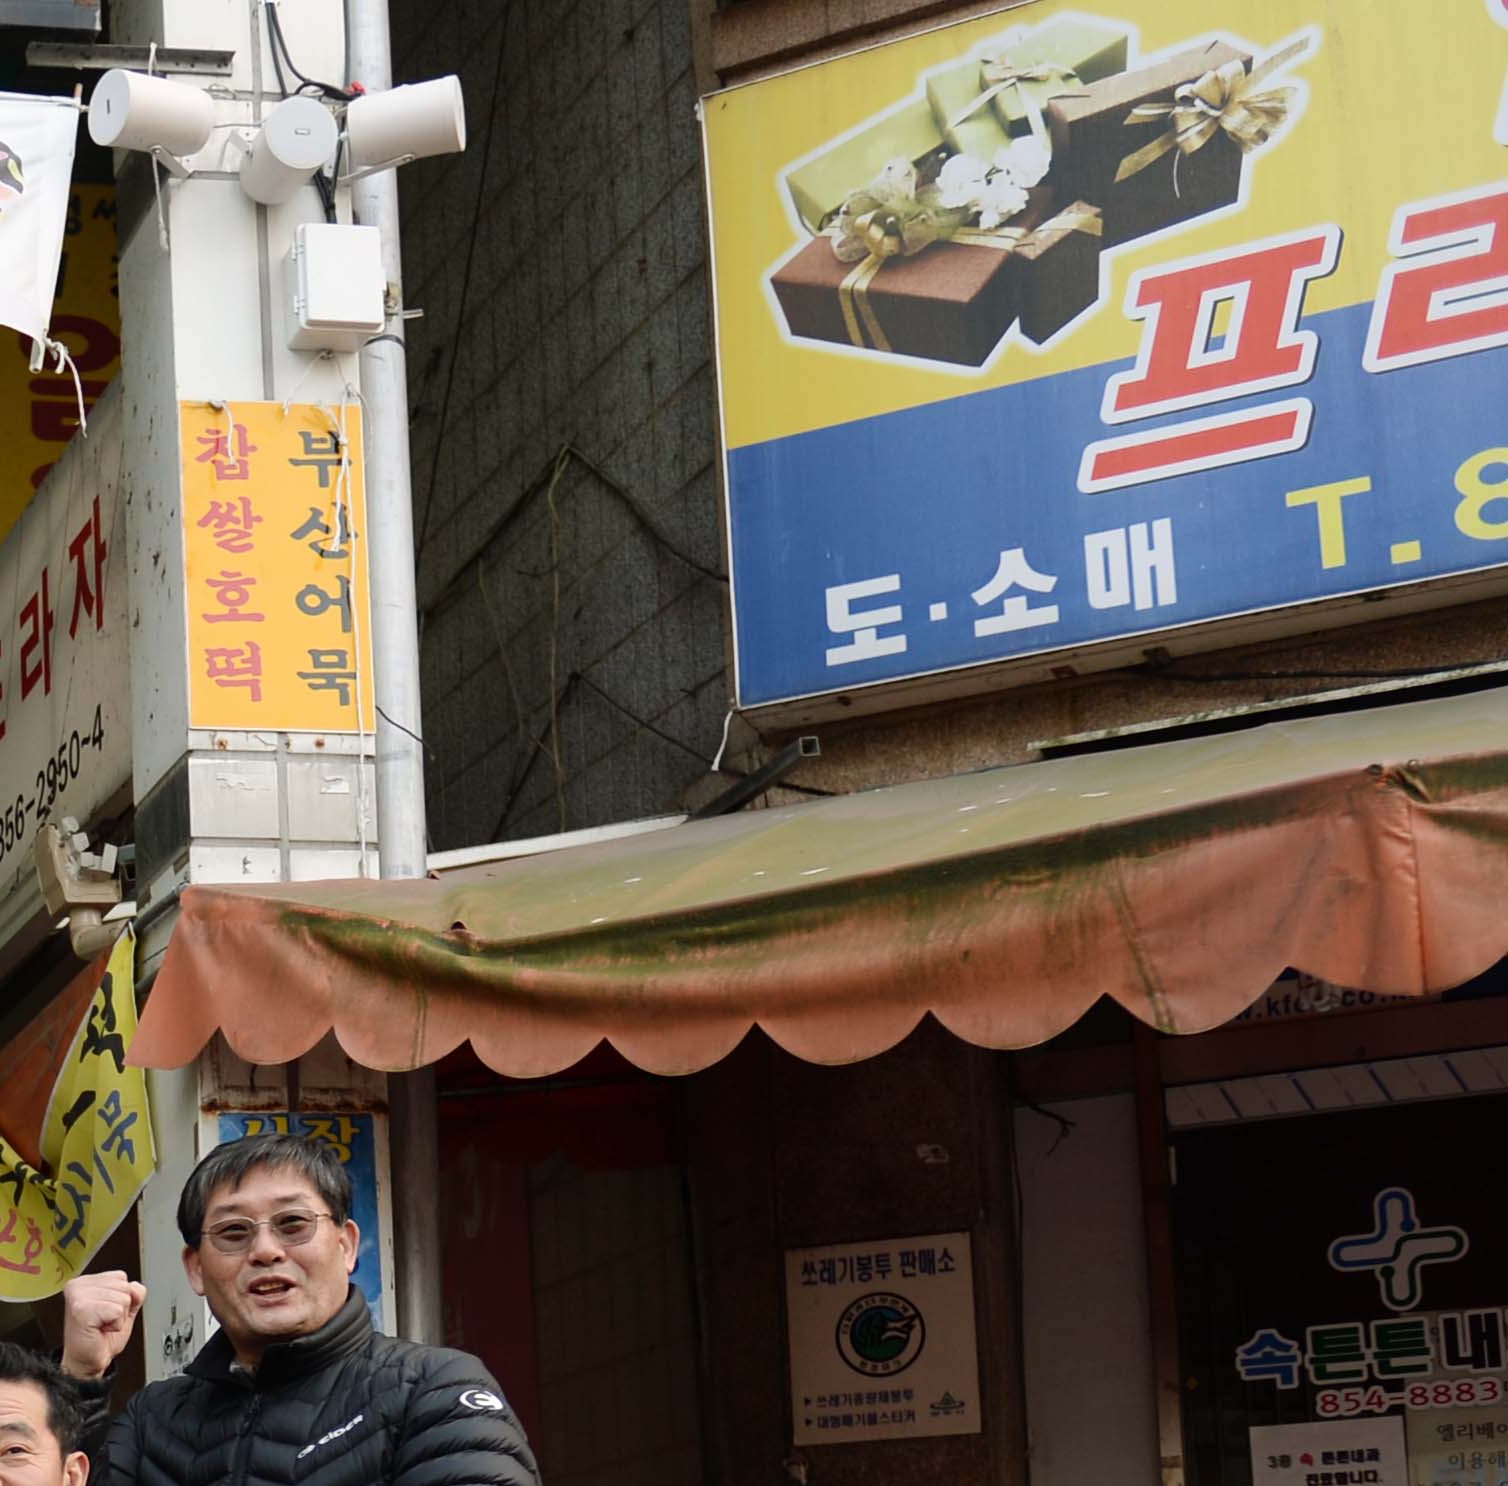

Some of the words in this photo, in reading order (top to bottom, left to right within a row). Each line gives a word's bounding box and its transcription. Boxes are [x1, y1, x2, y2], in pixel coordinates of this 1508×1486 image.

[195, 424, 265, 703] 찹쌀호떡
[288, 430, 359, 707] 부산어묵
[801, 1253, 893, 1287] 쓰레기봉투
[899, 1247, 956, 1279] 판매소
[1318, 1380, 1500, 1417] 854-8883
